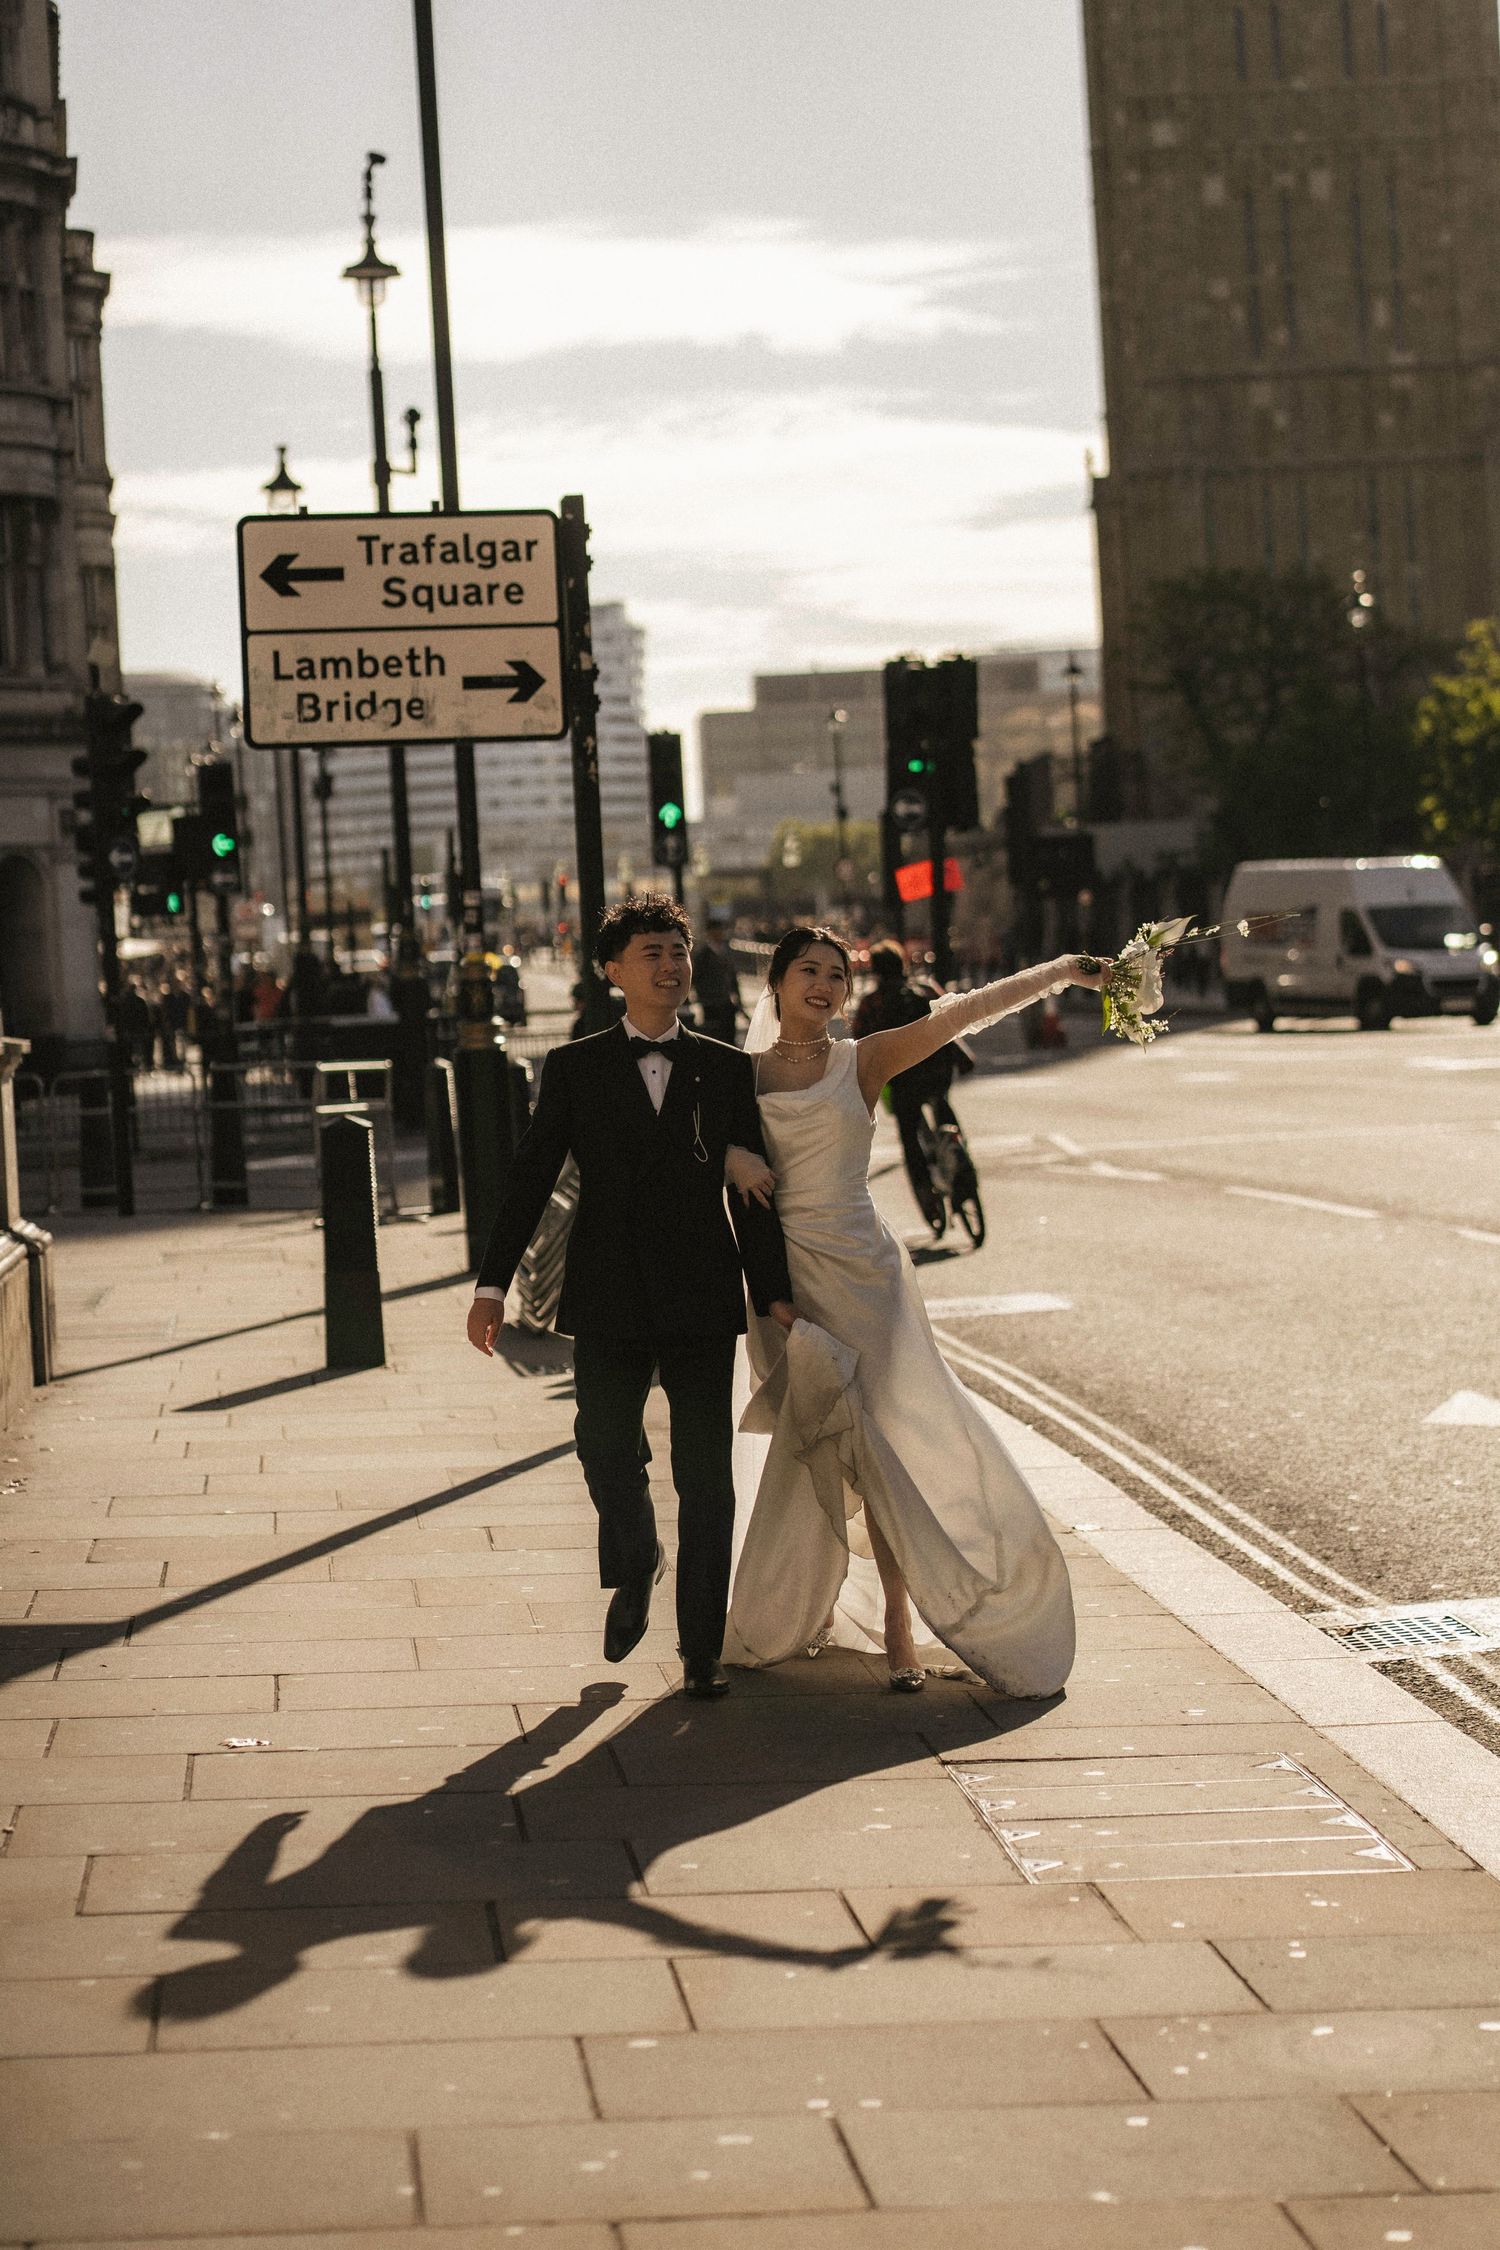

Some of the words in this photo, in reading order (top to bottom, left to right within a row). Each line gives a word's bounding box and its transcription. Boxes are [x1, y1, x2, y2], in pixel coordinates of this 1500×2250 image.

[357, 533, 539, 569] Trafalgar
[382, 577, 525, 613] Square
[272, 646, 446, 681] Lambeth
